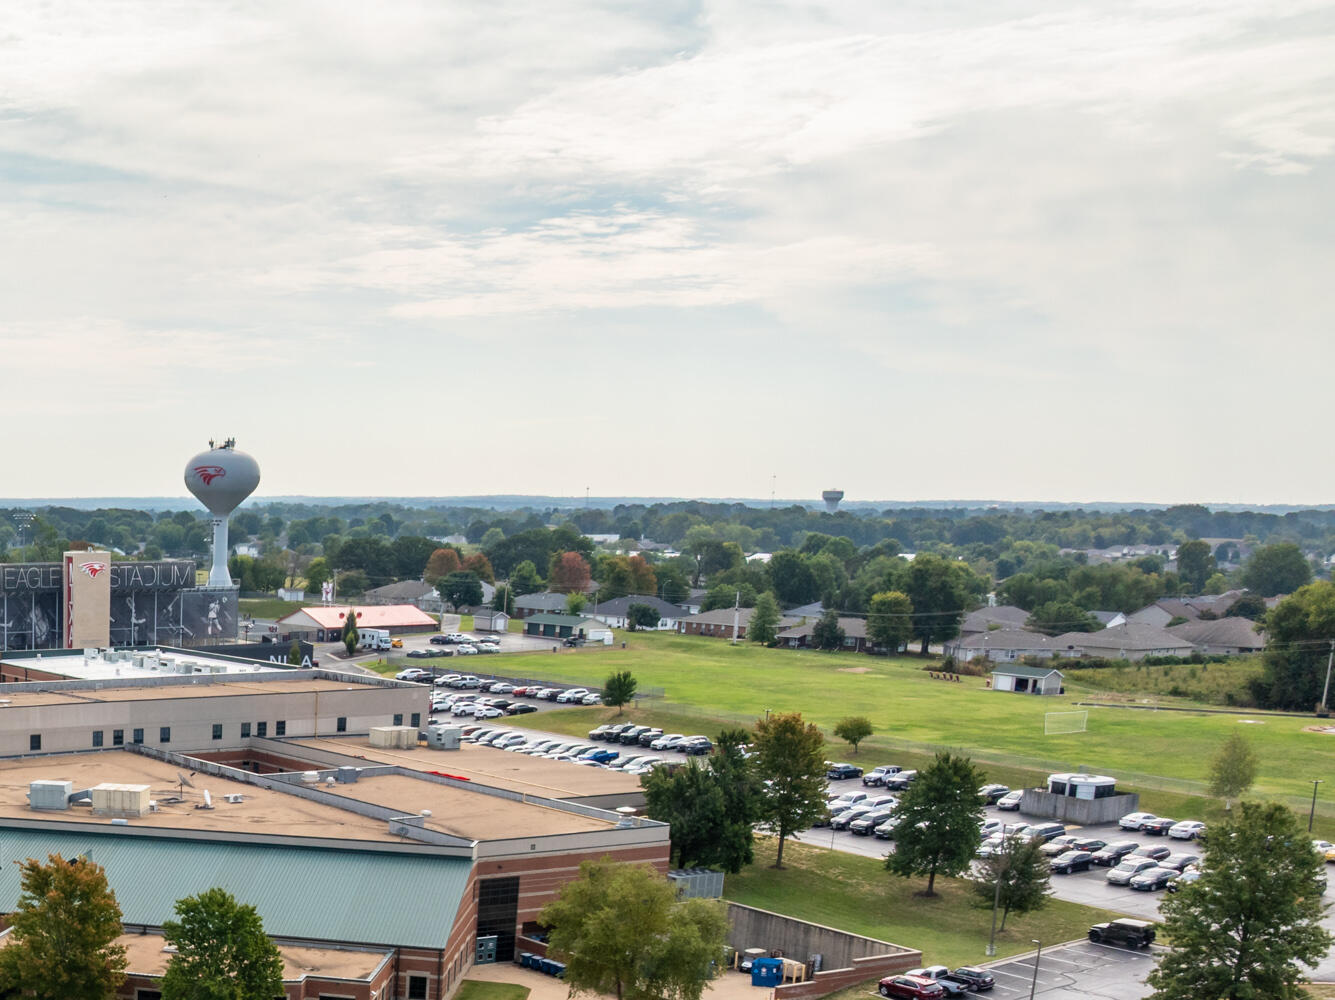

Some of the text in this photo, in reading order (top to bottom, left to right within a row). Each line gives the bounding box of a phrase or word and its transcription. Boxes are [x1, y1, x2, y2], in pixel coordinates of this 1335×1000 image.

[4, 565, 190, 589] EAGLE STADIUM
[269, 655, 312, 668] NIA
